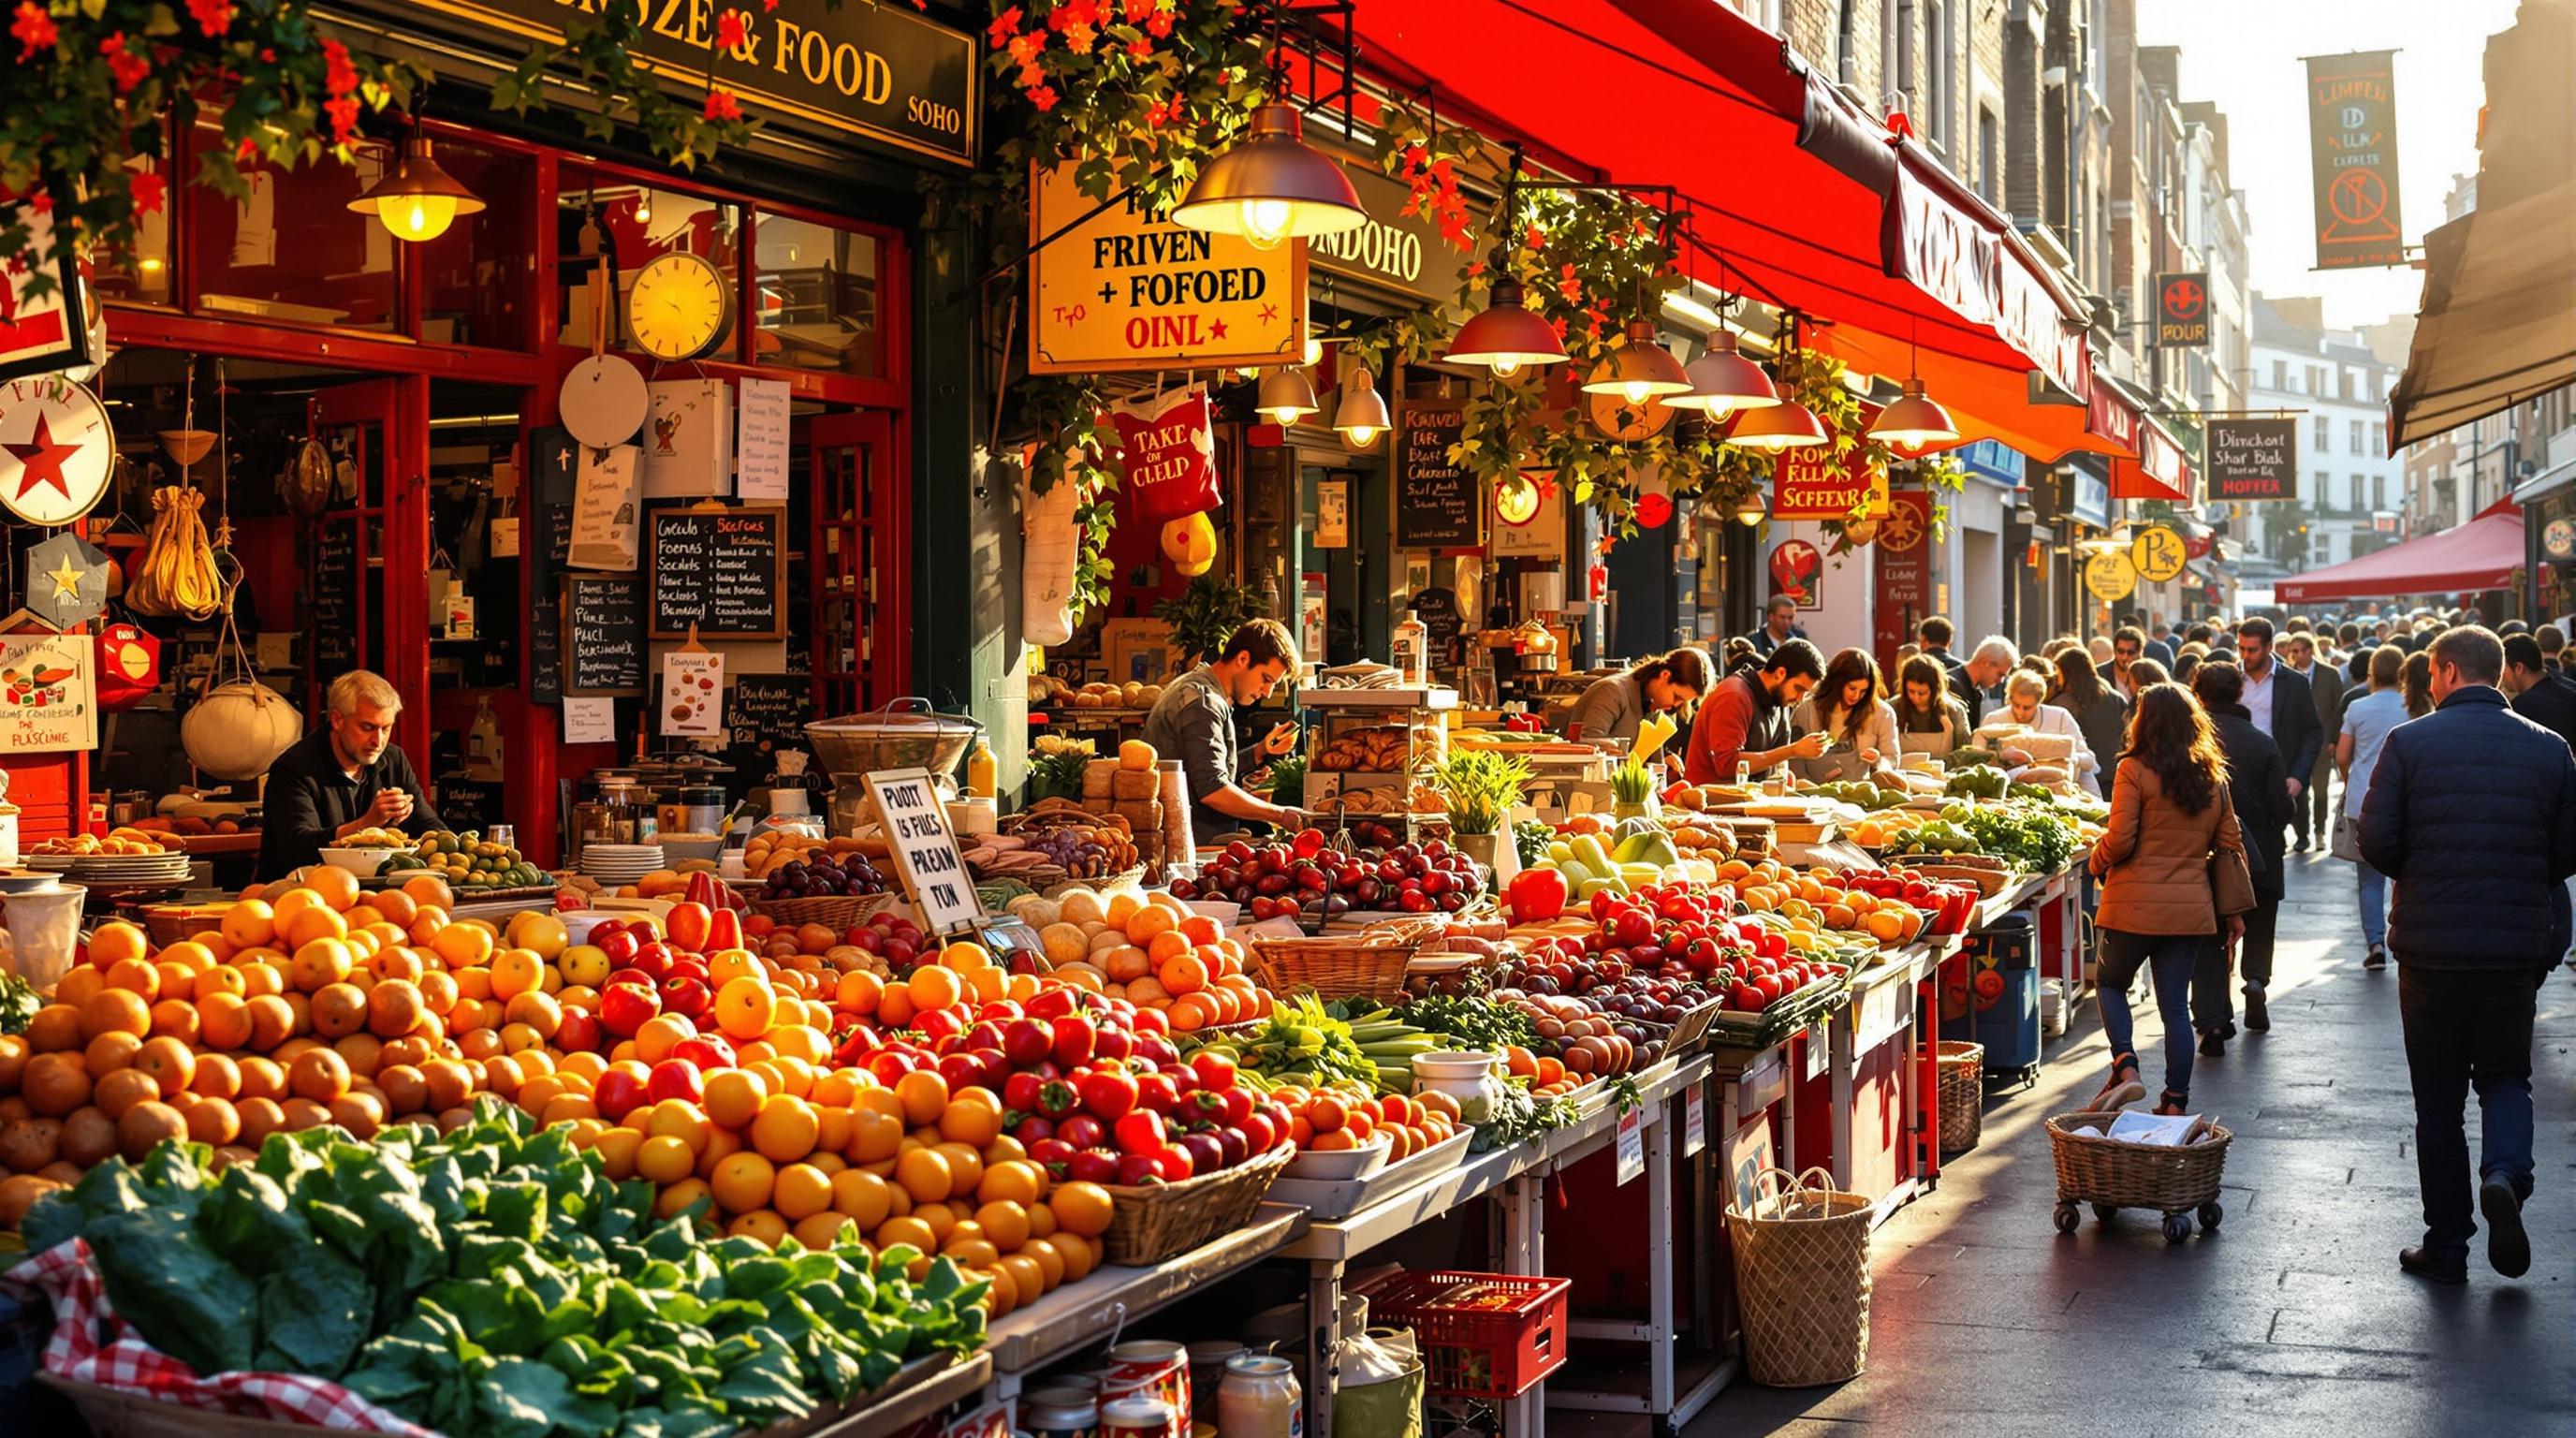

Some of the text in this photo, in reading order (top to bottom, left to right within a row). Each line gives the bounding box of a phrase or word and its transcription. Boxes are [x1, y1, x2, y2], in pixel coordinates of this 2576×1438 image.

[773, 18, 892, 105] FOOD
[907, 95, 960, 135] SOHO
[1093, 230, 1212, 269] FRIVEN
[1308, 219, 1422, 282] NDOHO
[1130, 267, 1266, 307] FOFOED
[1125, 315, 1205, 349] OINL
[2162, 323, 2205, 341] POUR
[1134, 423, 1187, 453] TAKE
